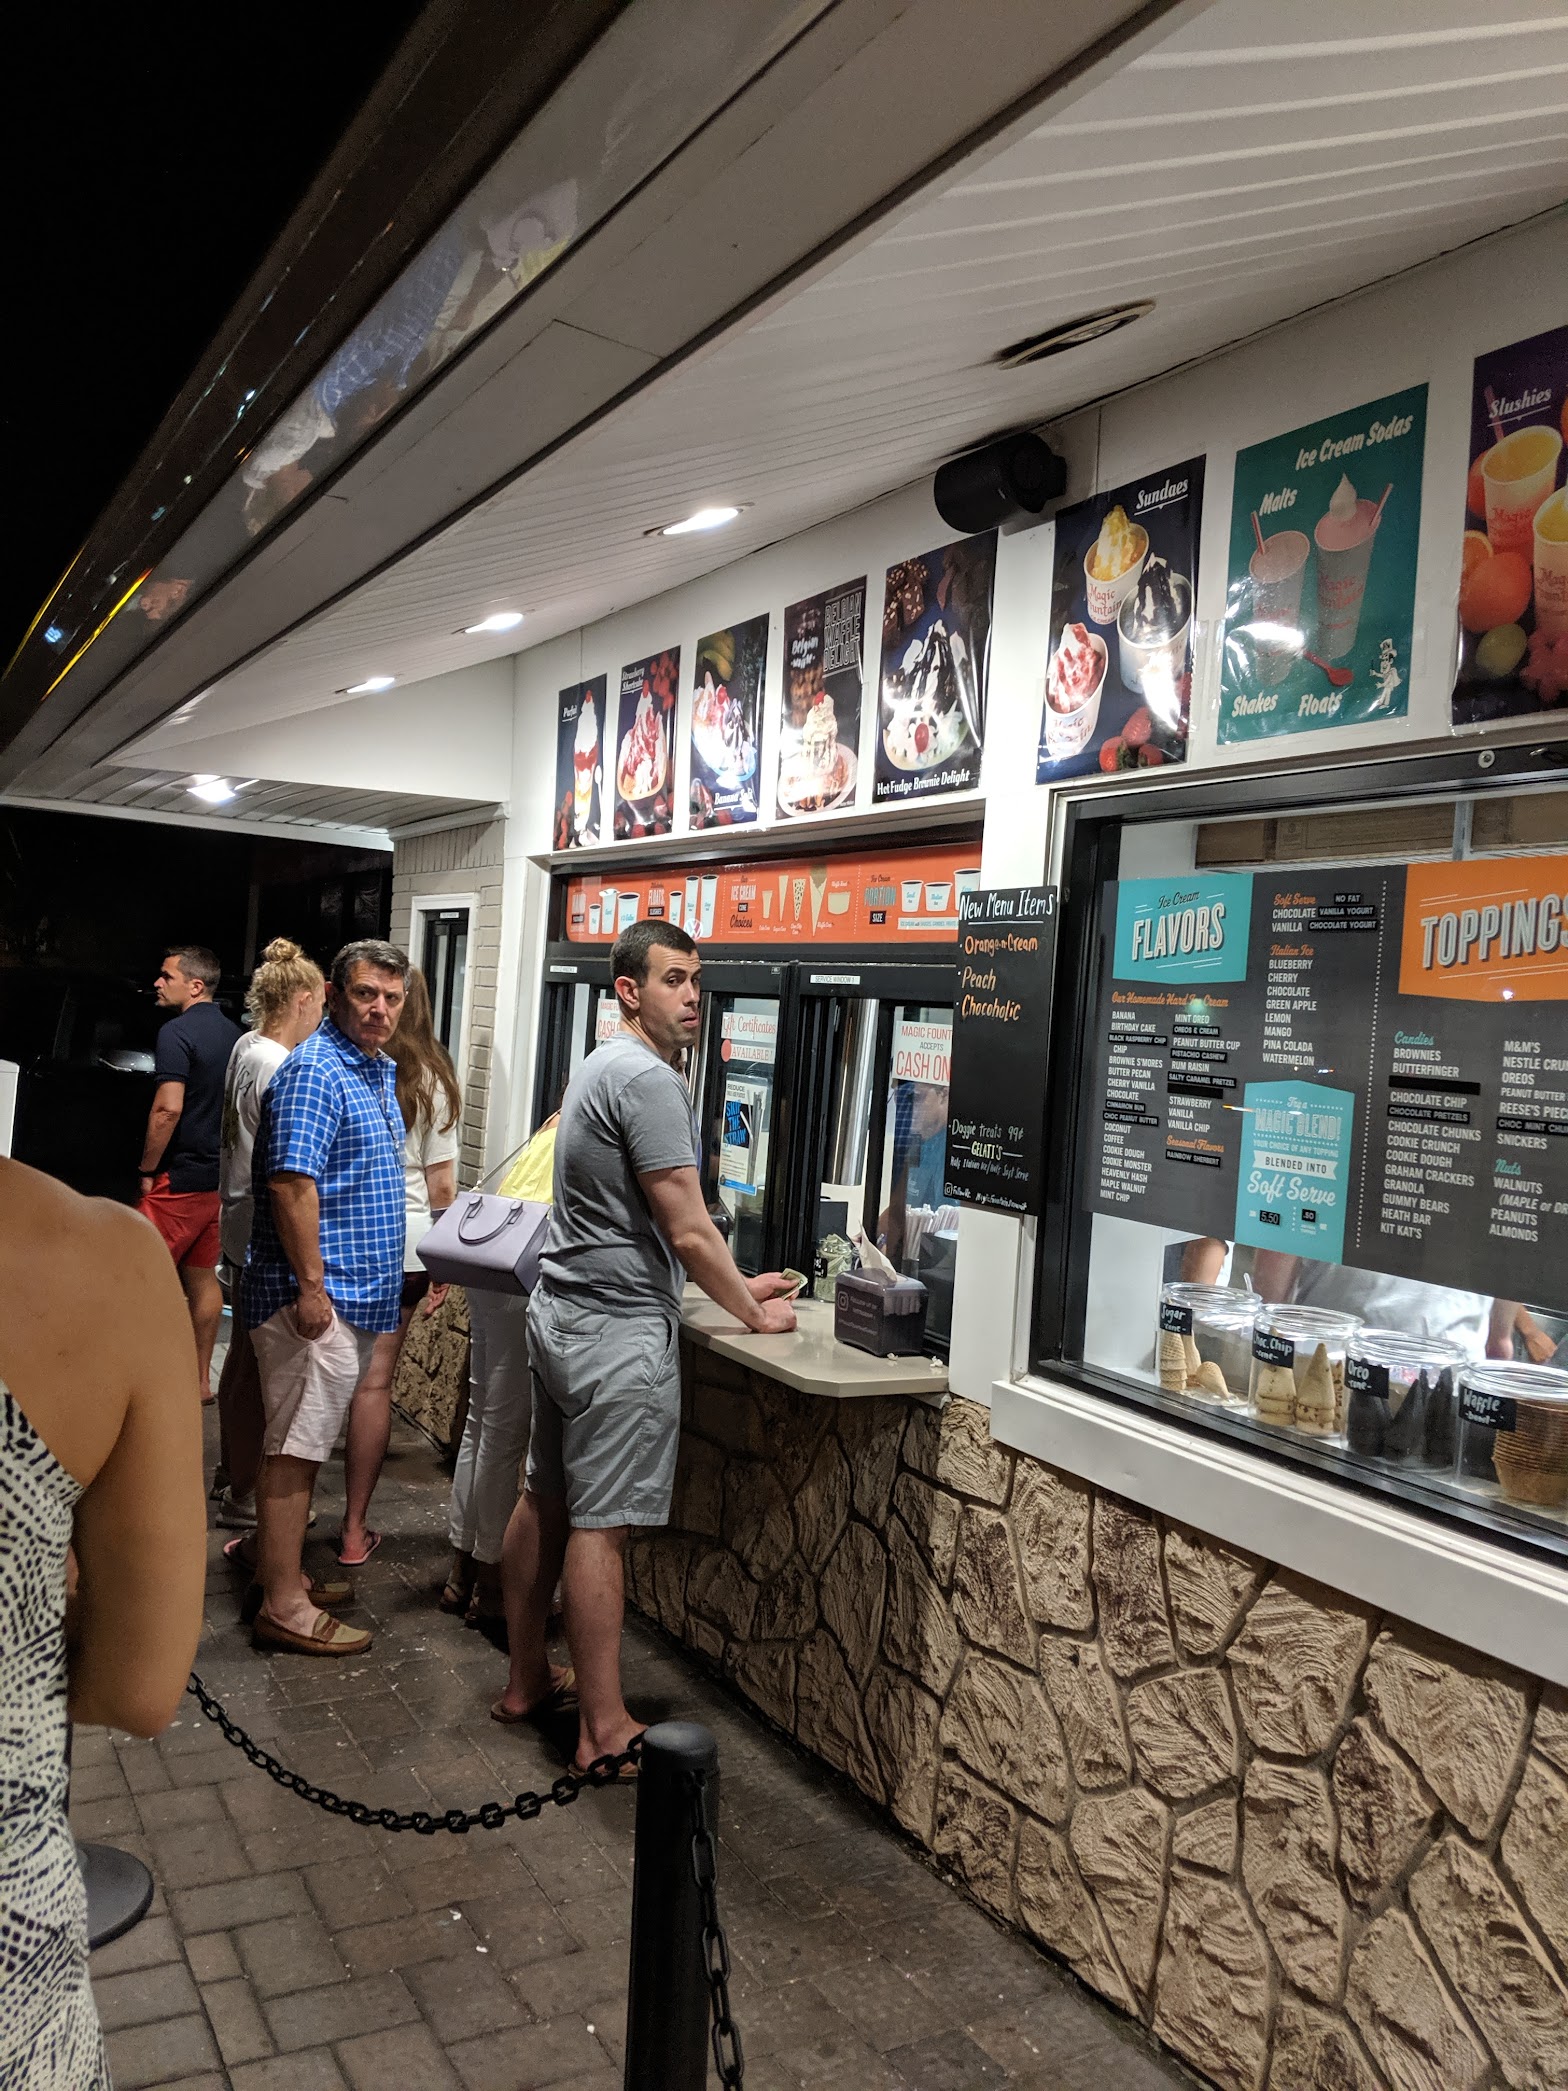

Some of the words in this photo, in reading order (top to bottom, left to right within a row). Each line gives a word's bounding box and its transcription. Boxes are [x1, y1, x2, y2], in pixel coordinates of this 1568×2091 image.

[1488, 387, 1552, 418] Slushies
[1295, 448, 1315, 470] Ice
[1318, 433, 1365, 463] Cream
[1366, 414, 1414, 446] Sodas
[1135, 478, 1189, 509] Sundaes
[1258, 487, 1298, 516] Malts
[1089, 583, 1115, 605] Magic
[823, 613, 860, 649] WAFFLE
[791, 635, 819, 658] Belgian
[823, 636, 860, 672] DELIGHT
[1231, 691, 1278, 718] Shakes
[1297, 692, 1343, 716] Floats
[877, 781, 890, 796] Hot
[890, 779, 912, 795] Fudge
[913, 775, 940, 791] Brownie
[940, 768, 970, 786] Delight
[730, 885, 739, 901] ICE
[739, 884, 757, 900] CREAM
[863, 886, 897, 907] PORTION
[1158, 895, 1171, 909] Ice
[1172, 891, 1200, 906] Cream
[1273, 892, 1293, 908] Soft
[1347, 894, 1360, 902] FAT
[959, 894, 983, 921] New
[985, 892, 1014, 919] Menu
[1015, 889, 1054, 918] Items
[1272, 907, 1317, 919] CHOCOLATE
[1319, 907, 1345, 915] VANILLA
[1346, 906, 1374, 915] YOGURT
[729, 914, 753, 928] Choices
[872, 912, 883, 923] SIZE
[1309, 921, 1347, 929] CHOCOLATE
[1349, 920, 1377, 929] YOGURT
[1131, 902, 1226, 962] FLAVORS
[1271, 921, 1303, 932] VANILLA
[1270, 944, 1299, 956] Italian
[1268, 959, 1313, 969] BLUEBERRY
[815, 975, 832, 983] SERVICE
[961, 965, 997, 992] Peach
[1267, 972, 1299, 983] CHERRY
[1126, 991, 1165, 1005] Homemade
[1203, 994, 1229, 1007] Cream
[1266, 986, 1311, 997] CHOCOLATE
[1265, 999, 1291, 1010] GREEN
[1291, 1000, 1317, 1011] APPLE
[1111, 1010, 1136, 1020] BANANA
[1174, 1013, 1192, 1024] MINT
[1192, 1014, 1210, 1024] OREO
[1264, 1012, 1291, 1024] LEMON
[597, 1019, 616, 1039] CASH
[737, 1015, 777, 1040] Certificates
[901, 1025, 926, 1038] MAGIC
[1110, 1022, 1140, 1032] BIRTHDAY
[1140, 1023, 1156, 1033] CAKE
[1198, 1027, 1219, 1036] CREAM
[1264, 1025, 1292, 1037] MANGO
[919, 1041, 944, 1051] ACCEPTS
[1173, 1037, 1199, 1048] PEANUT
[1199, 1039, 1225, 1050] BUTTER
[1225, 1040, 1241, 1051] CUP
[1263, 1039, 1281, 1050] PINA
[1282, 1040, 1313, 1053] COLADA
[1394, 1030, 1435, 1046] Candies
[1113, 1044, 1128, 1054] CHIP
[1393, 1047, 1442, 1062] BROWNIES
[1503, 1040, 1541, 1054] M&M'S
[895, 1050, 931, 1080] CASH
[1108, 1055, 1136, 1066] BROWNIE
[1171, 1060, 1187, 1071] RUM
[1187, 1062, 1210, 1073] RAISIN
[1262, 1052, 1315, 1066] WATERMELON
[1502, 1056, 1541, 1070] NESTLE
[1107, 1066, 1131, 1077] BUTTER
[1131, 1068, 1151, 1079] PECAN
[1392, 1062, 1460, 1078] BUTTERFINGER
[1501, 1071, 1535, 1085] OREOS
[727, 1083, 746, 1092] REDUCE
[1107, 1077, 1131, 1089] CHERRY
[1131, 1079, 1156, 1091] VANILLA
[1106, 1088, 1139, 1101] CHOCOLATE
[1169, 1095, 1212, 1109] STRAWBERRY
[1389, 1091, 1442, 1107] CHOCOLATE
[1443, 1095, 1468, 1109] CHIP
[1500, 1087, 1533, 1099] PEANUT
[1533, 1089, 1566, 1102] BUTTER
[1168, 1107, 1194, 1119] VANILLA
[1388, 1106, 1432, 1118] CHOCOLATE
[1432, 1110, 1468, 1122] PRETZELS
[1499, 1101, 1541, 1117] REESE'S
[727, 1114, 741, 1132] THE
[951, 1118, 977, 1140] Doggie
[979, 1122, 1002, 1139] treats
[1007, 1125, 1025, 1142] 99¢
[1104, 1122, 1132, 1134] COCONUT
[1167, 1119, 1193, 1131] VANILLA
[1194, 1122, 1211, 1133] CHIP
[1254, 1107, 1294, 1135] MAGIC
[1296, 1113, 1342, 1141] BLEND!
[1387, 1120, 1440, 1137] CHOCOLATE
[1441, 1125, 1482, 1142] CHUNKS
[1498, 1118, 1523, 1129] CHOC
[1524, 1121, 1546, 1131] MINT
[723, 1127, 747, 1146] STRAW
[1103, 1133, 1124, 1145] COFFEE
[1386, 1134, 1419, 1149] COOKIE
[1421, 1138, 1461, 1154] CRUNCH
[1496, 1132, 1548, 1150] SNICKERS
[971, 1140, 1003, 1161] GELATI'S
[1102, 1144, 1123, 1156] COOKIE
[1124, 1147, 1145, 1159] DOUGH
[1385, 1149, 1419, 1163] COOKIE
[1420, 1153, 1453, 1168] DOUGH
[962, 1158, 981, 1170] Italian
[1001, 1164, 1015, 1180] Soft
[1014, 1166, 1030, 1182] Serve
[1101, 1156, 1123, 1167] COOKIE
[1123, 1158, 1153, 1173] MONSTER
[1265, 1156, 1303, 1171] BLENDED
[1305, 1162, 1327, 1174] INTO
[1494, 1158, 1521, 1176] Nuts
[1101, 1167, 1130, 1180] HEAVENLY
[1130, 1170, 1148, 1183] HASH
[1384, 1163, 1424, 1179] GRAHAM
[1425, 1169, 1475, 1187] CRACKERS
[1100, 1178, 1121, 1190] MAPLE
[1121, 1180, 1146, 1194] WALNUT
[1246, 1170, 1285, 1204] Soft
[1286, 1176, 1336, 1207] Serve
[1383, 1178, 1425, 1195] GRANOLA
[1493, 1176, 1543, 1195] WALNUTS
[1099, 1189, 1115, 1200] MINT
[1115, 1191, 1131, 1202] CHIP
[1382, 1192, 1418, 1208] GUMMY
[1419, 1198, 1450, 1214] BEARS
[1498, 1193, 1539, 1210] (MAPLE
[1381, 1207, 1411, 1222] HEATH
[1412, 1212, 1432, 1226] BAR
[1490, 1207, 1538, 1226] PEANUTS
[1380, 1221, 1396, 1234] KIT
[1396, 1224, 1423, 1240] KAT'S
[1488, 1223, 1539, 1242] ALMONDS
[1161, 1303, 1187, 1324] Sugar
[1269, 1337, 1293, 1357] Chip
[1347, 1360, 1370, 1381] Oreo
[1463, 1388, 1500, 1413] Waffle
